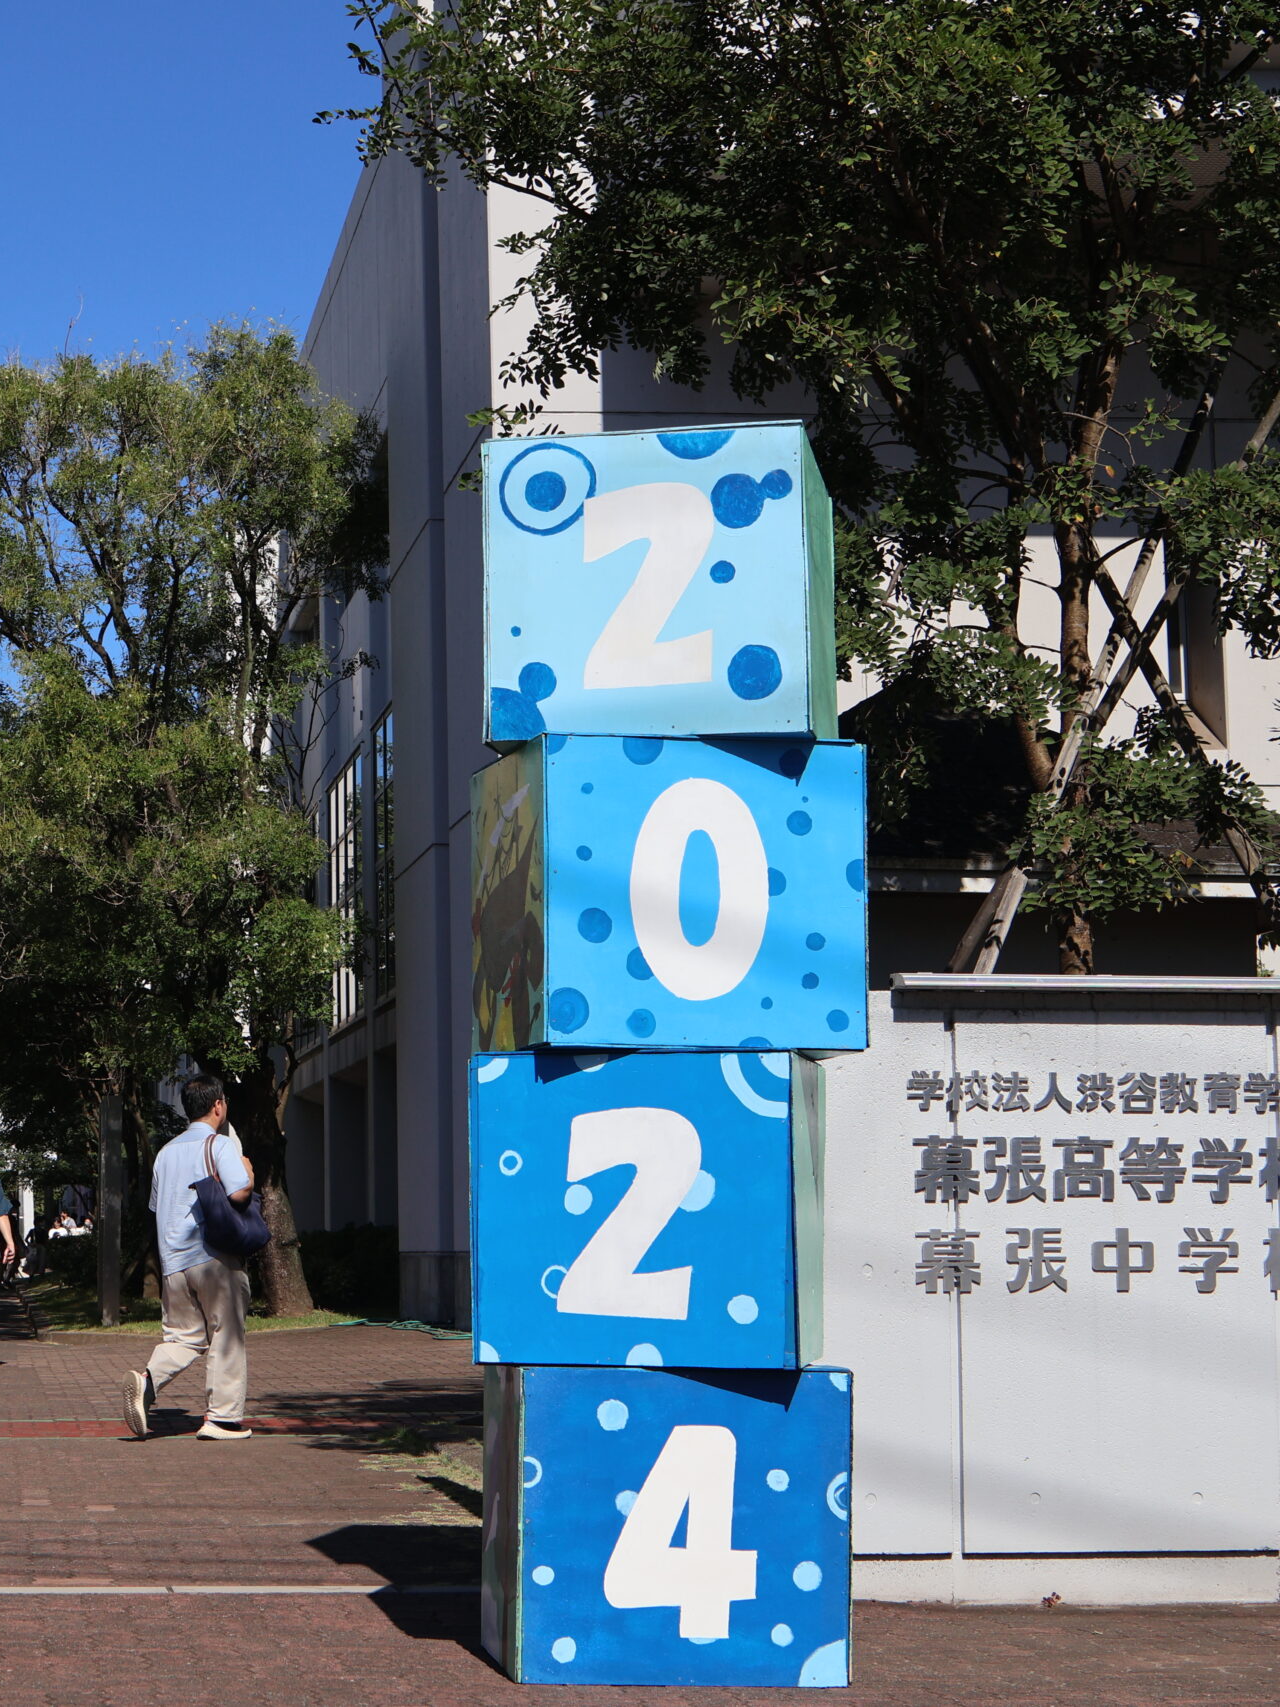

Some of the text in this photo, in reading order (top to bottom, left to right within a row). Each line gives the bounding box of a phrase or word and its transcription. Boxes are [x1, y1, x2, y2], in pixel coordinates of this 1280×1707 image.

[907, 1071, 1280, 1114] 学校法人渋谷教育学
[915, 1227, 1280, 1294] 幕張中学
